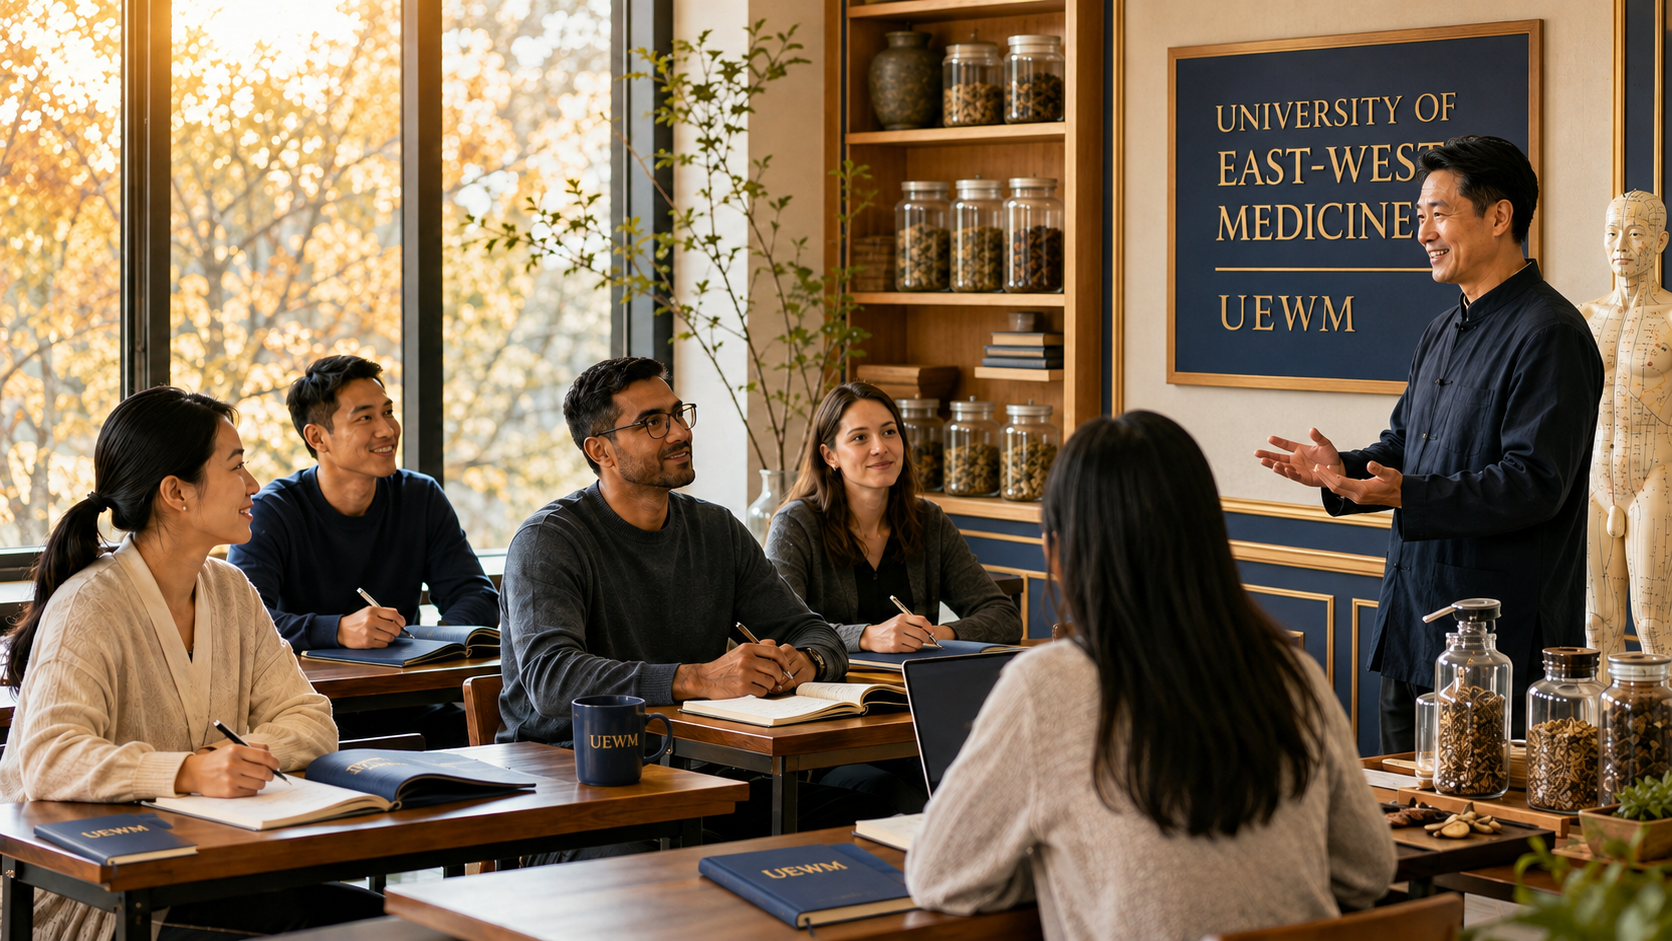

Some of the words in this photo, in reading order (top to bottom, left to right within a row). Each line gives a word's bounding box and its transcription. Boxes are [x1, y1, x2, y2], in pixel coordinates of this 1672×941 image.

[1215, 95, 1402, 133] UNIVERSITY
[1414, 92, 1456, 123] OF
[1215, 201, 1414, 241] MEDICINE
[1218, 294, 1356, 333] UEWM
[589, 732, 639, 749] UEWM
[81, 824, 149, 839] UEWM
[761, 860, 849, 880] UEWM
